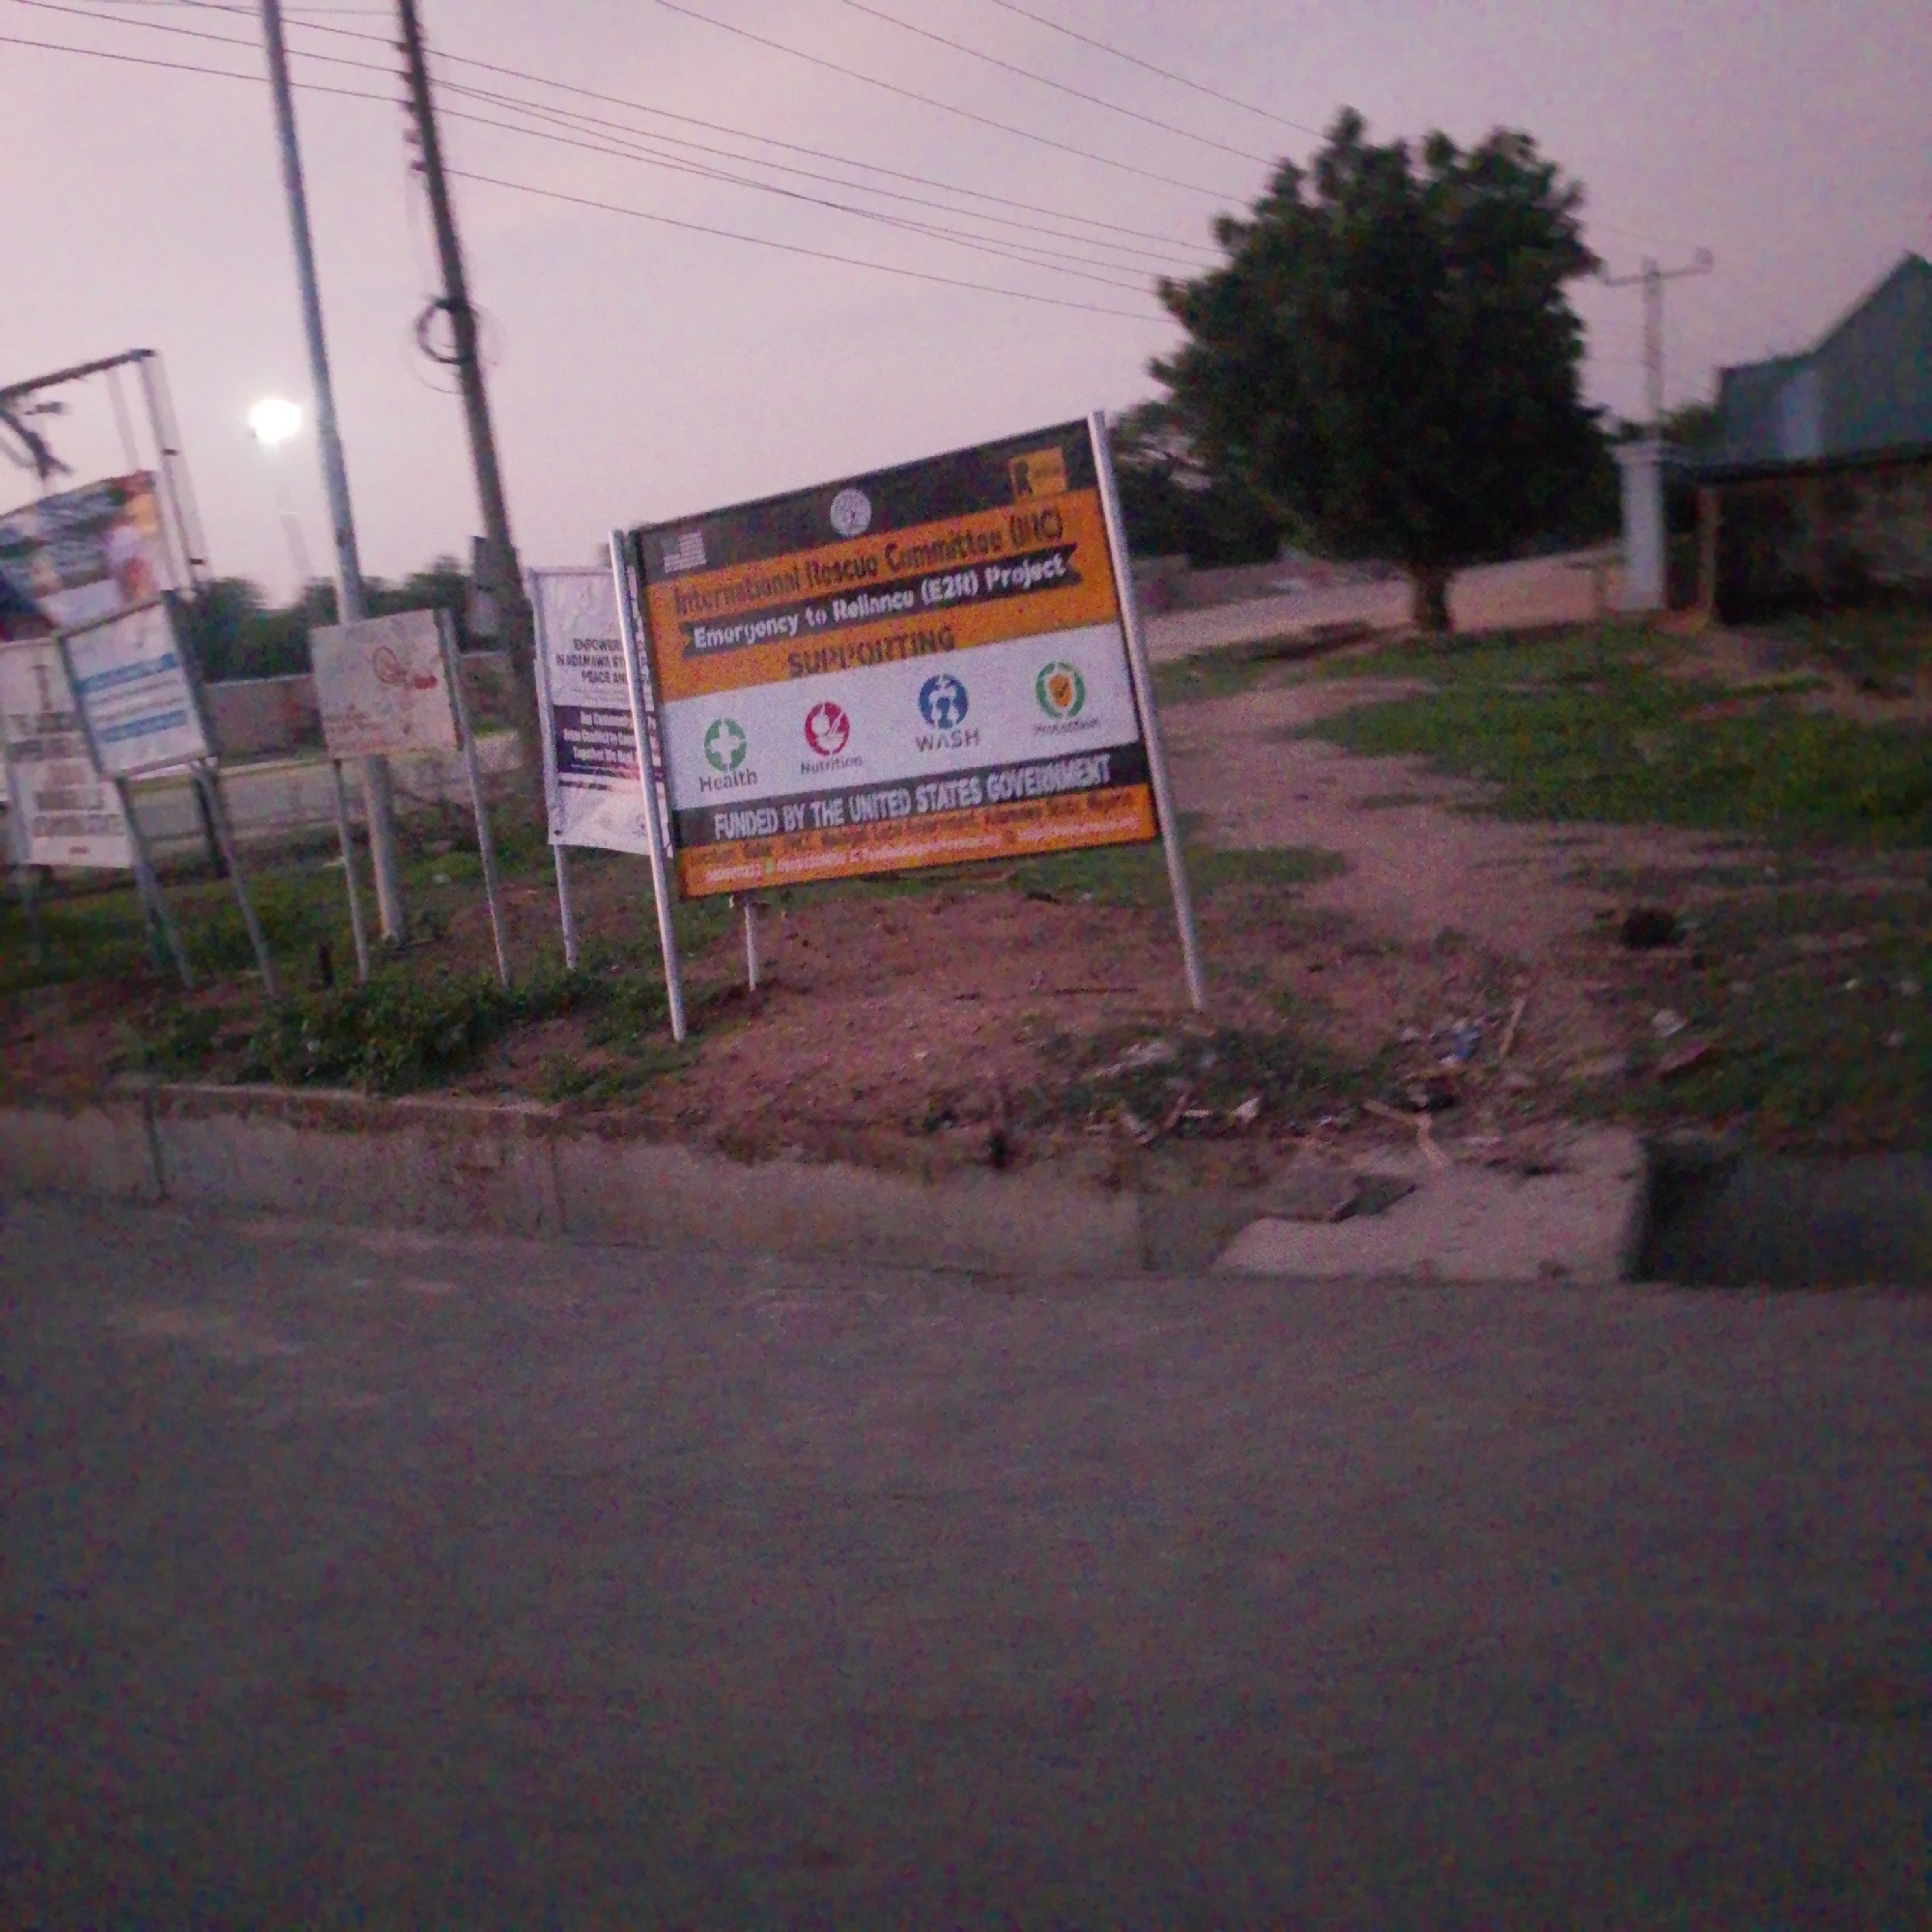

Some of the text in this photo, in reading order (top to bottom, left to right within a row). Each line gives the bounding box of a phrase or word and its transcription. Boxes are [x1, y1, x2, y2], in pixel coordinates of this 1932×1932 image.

[674, 508, 1064, 615] International Rescue Committee (IRC)
[694, 612, 799, 649] Emergency
[806, 605, 828, 628] to
[921, 568, 980, 606] (E2R)
[984, 552, 1067, 590] Project
[788, 626, 955, 677] SUPPORTING
[801, 754, 863, 775] Nutrition
[915, 726, 980, 753] WASH
[698, 767, 758, 792] Health
[714, 806, 779, 841] FUNDED
[782, 803, 806, 833] BY
[810, 797, 845, 828] THE
[849, 786, 911, 822] UNITED
[915, 775, 983, 813] STATES
[985, 753, 1112, 801] GOVERNMENT
